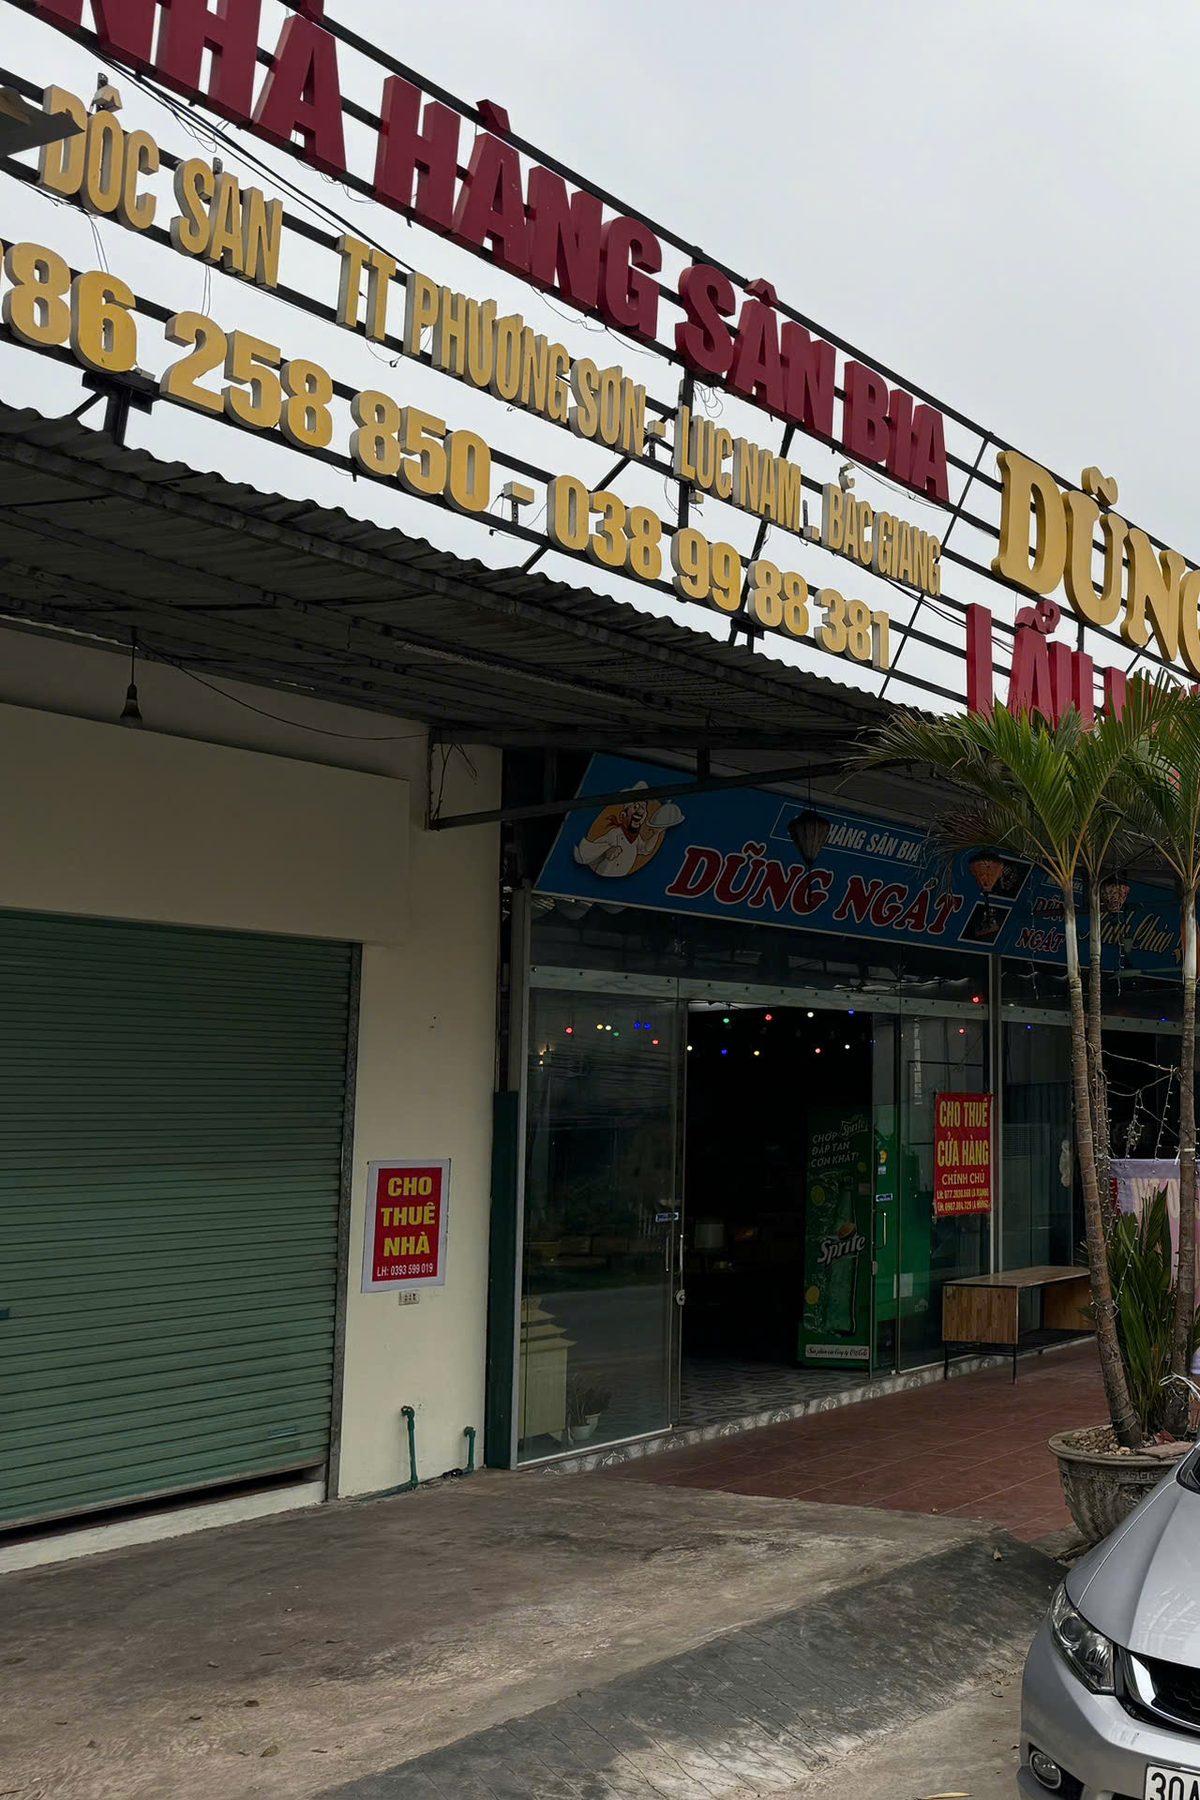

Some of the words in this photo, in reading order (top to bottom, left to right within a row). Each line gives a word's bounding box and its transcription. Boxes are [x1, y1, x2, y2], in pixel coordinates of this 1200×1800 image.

[374, 75, 661, 342] HÀNG
[675, 264, 835, 436] SÂN
[843, 361, 949, 503] BIA
[336, 234, 396, 342] TT
[872, 511, 942, 597] GIANG
[0, 241, 137, 375] 86
[159, 311, 333, 449] 258
[350, 390, 491, 512] 850
[547, 475, 662, 580] 038
[671, 528, 741, 611] 99
[747, 560, 808, 637] 88
[814, 588, 890, 670] 381
[869, 832, 898, 857] SÂN
[899, 839, 922, 863] BIA
[665, 841, 834, 915] DŨNG
[833, 875, 964, 936] NGÁT
[940, 1100, 961, 1128] CHO
[962, 1134, 989, 1166] HÀNG
[387, 1176, 432, 1197] CHO
[381, 1201, 436, 1227] THUÊ
[383, 1231, 430, 1257] NHÀ
[817, 1234, 866, 1264] Sprite
